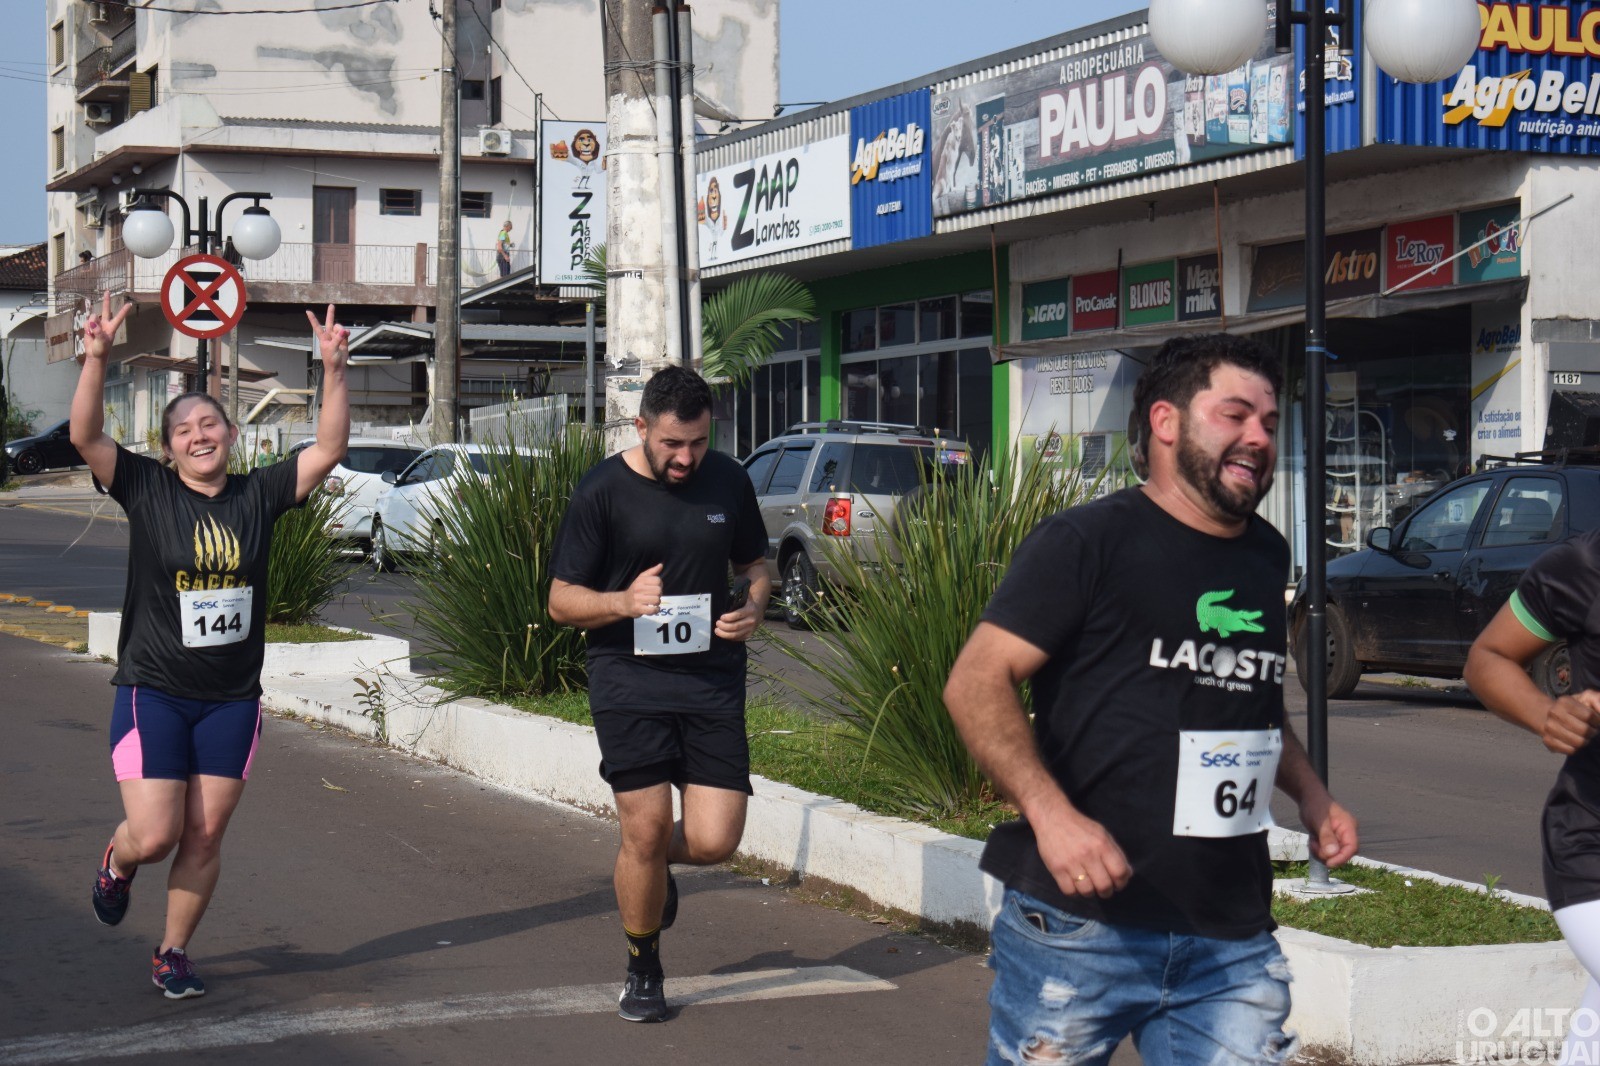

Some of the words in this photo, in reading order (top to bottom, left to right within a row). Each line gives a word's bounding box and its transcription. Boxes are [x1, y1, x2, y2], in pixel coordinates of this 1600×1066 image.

[1060, 43, 1144, 85] AGROPECUÁRIA
[1039, 65, 1167, 158] PAULO
[1518, 119, 1573, 138] nutrição
[851, 122, 925, 178] AgroBella
[1025, 176, 1047, 197] RAÇÕES
[1052, 171, 1079, 190] MINERAIS
[1085, 167, 1097, 183] PET
[1103, 158, 1138, 179] FERRAGENS
[1144, 149, 1175, 170] DIVERSOS
[731, 157, 800, 251] ZAAP
[568, 191, 593, 271] ZAAP
[755, 213, 800, 247] Lanches
[1325, 250, 1377, 285] Astro
[1130, 280, 1171, 310] BLOKUS
[1185, 288, 1217, 313] milk
[1554, 374, 1580, 384] 1187
[1478, 426, 1491, 440] criar
[194, 612, 243, 637] 144
[656, 621, 692, 644] 10
[1149, 637, 1286, 685] LACOSTE
[1217, 678, 1226, 688] of
[1226, 681, 1253, 693] green
[1213, 779, 1258, 819] 64
